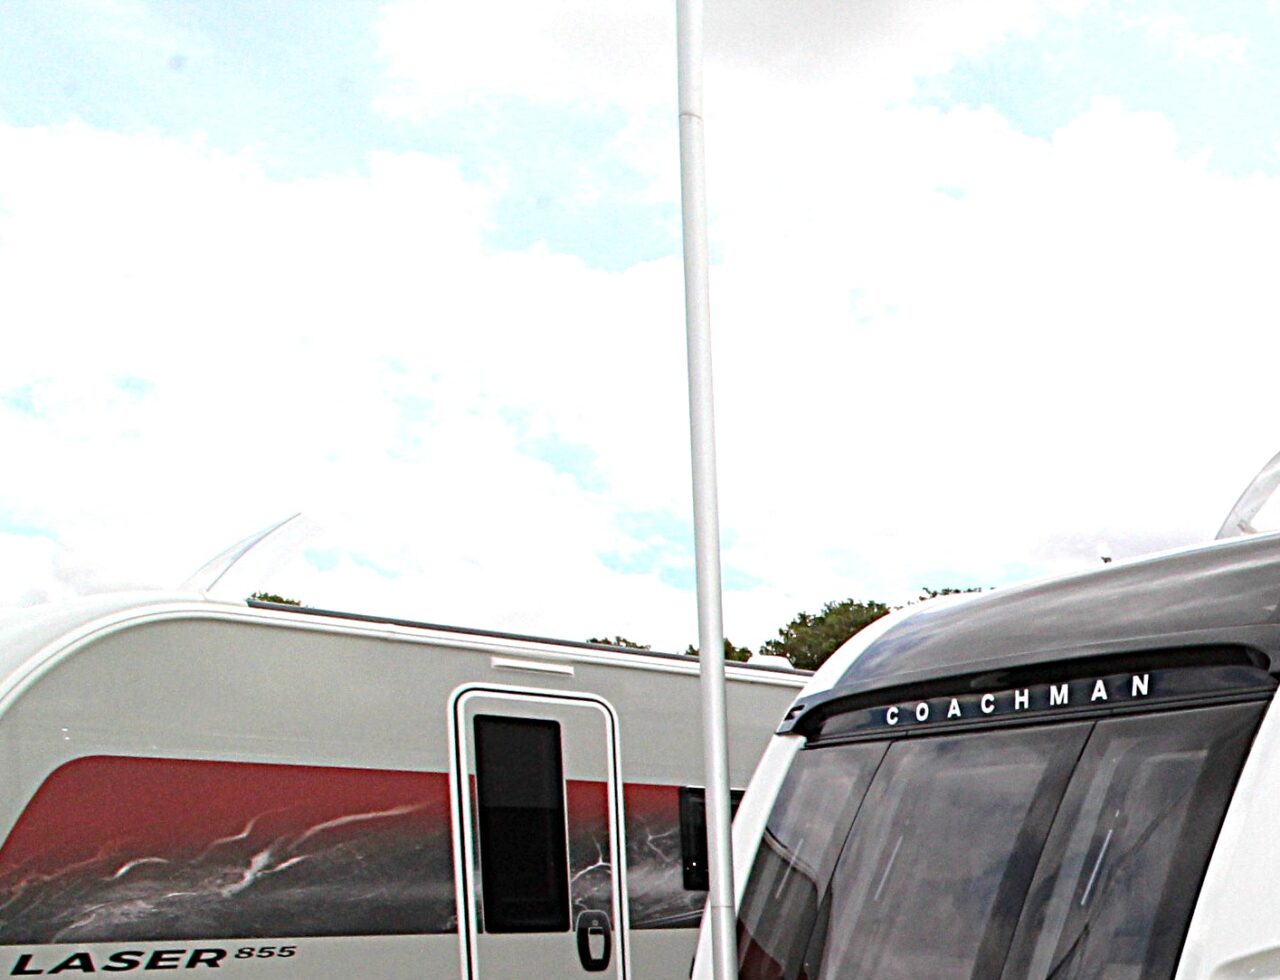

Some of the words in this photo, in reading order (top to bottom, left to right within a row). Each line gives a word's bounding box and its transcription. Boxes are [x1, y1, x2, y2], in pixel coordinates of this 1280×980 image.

[886, 674, 1150, 725] COACHMAN
[10, 948, 227, 975] LASER
[234, 946, 297, 959] 855
